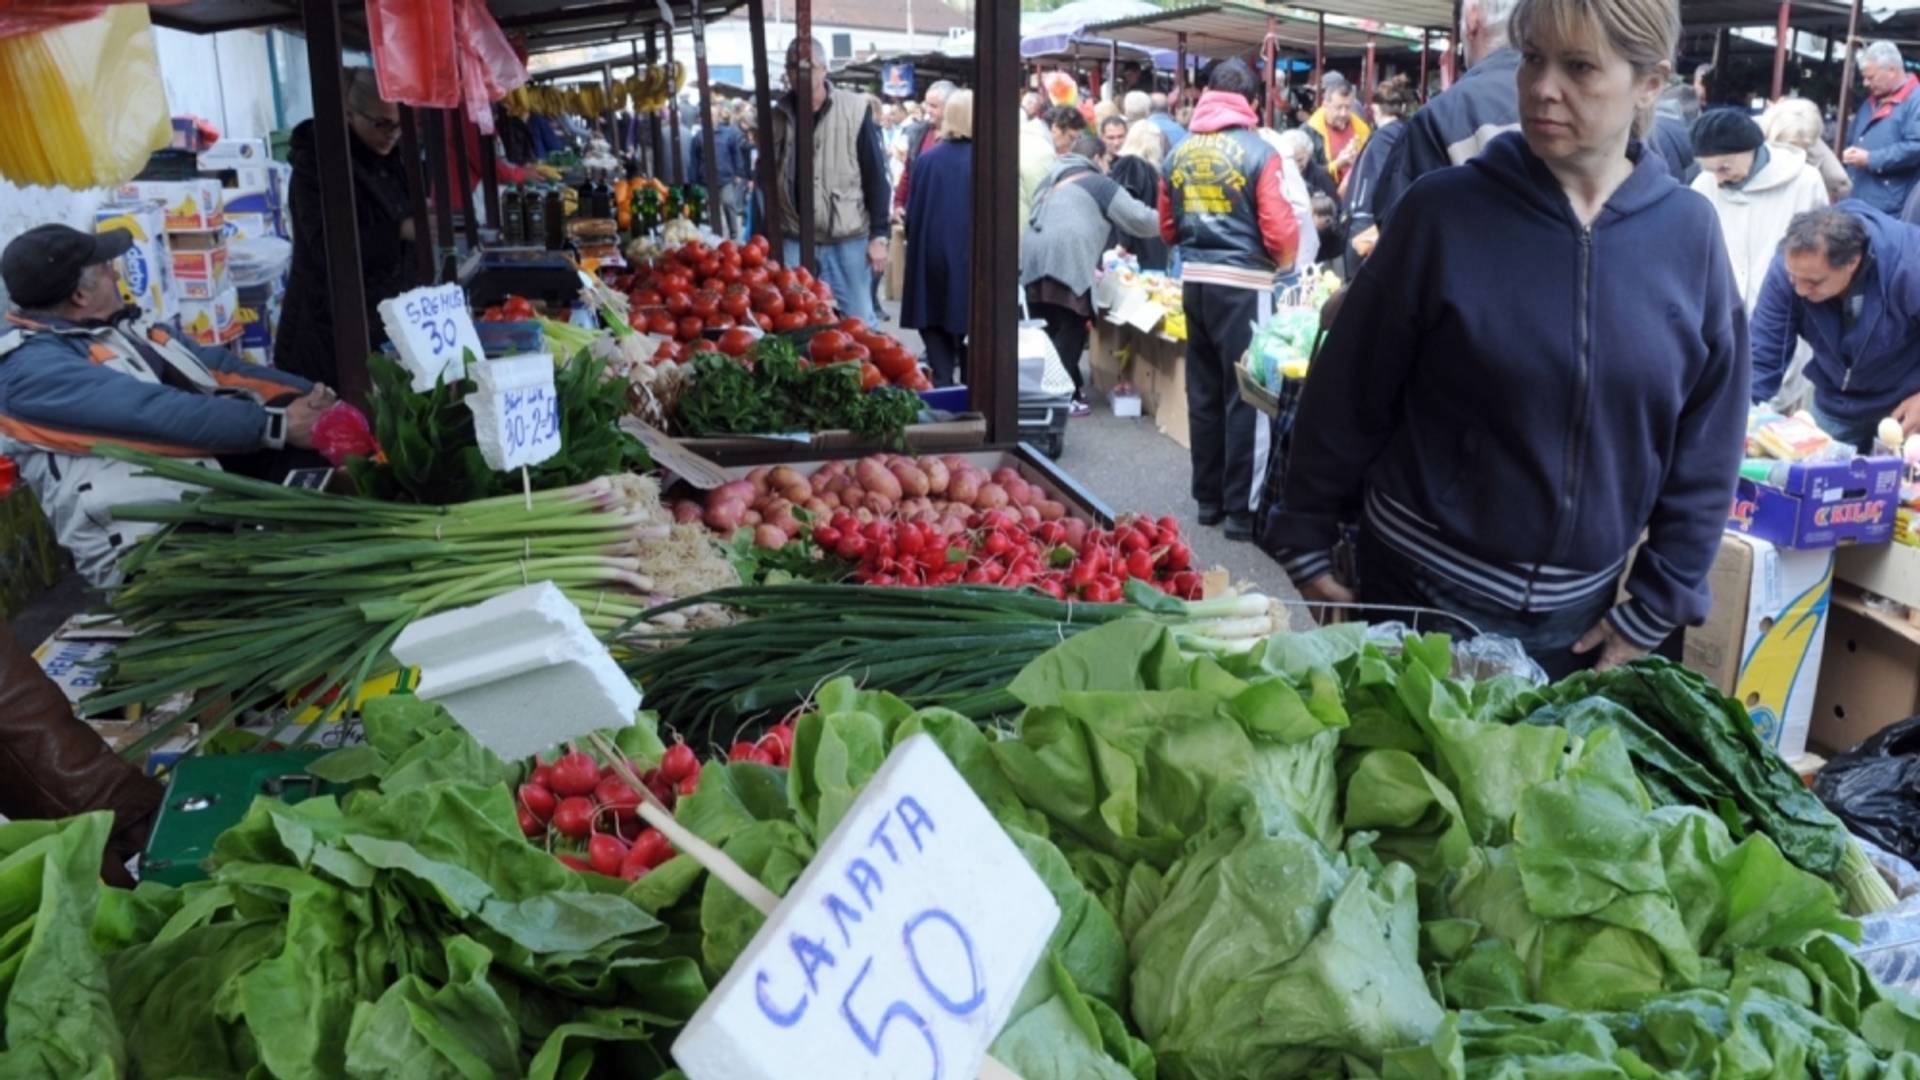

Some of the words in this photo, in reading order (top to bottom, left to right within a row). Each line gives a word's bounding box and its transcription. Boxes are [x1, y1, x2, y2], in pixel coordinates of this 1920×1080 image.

[127, 247, 143, 294] derby
[421, 318, 457, 355] 30
[755, 794, 937, 1028] САЛАТА
[838, 908, 987, 1080] 50
